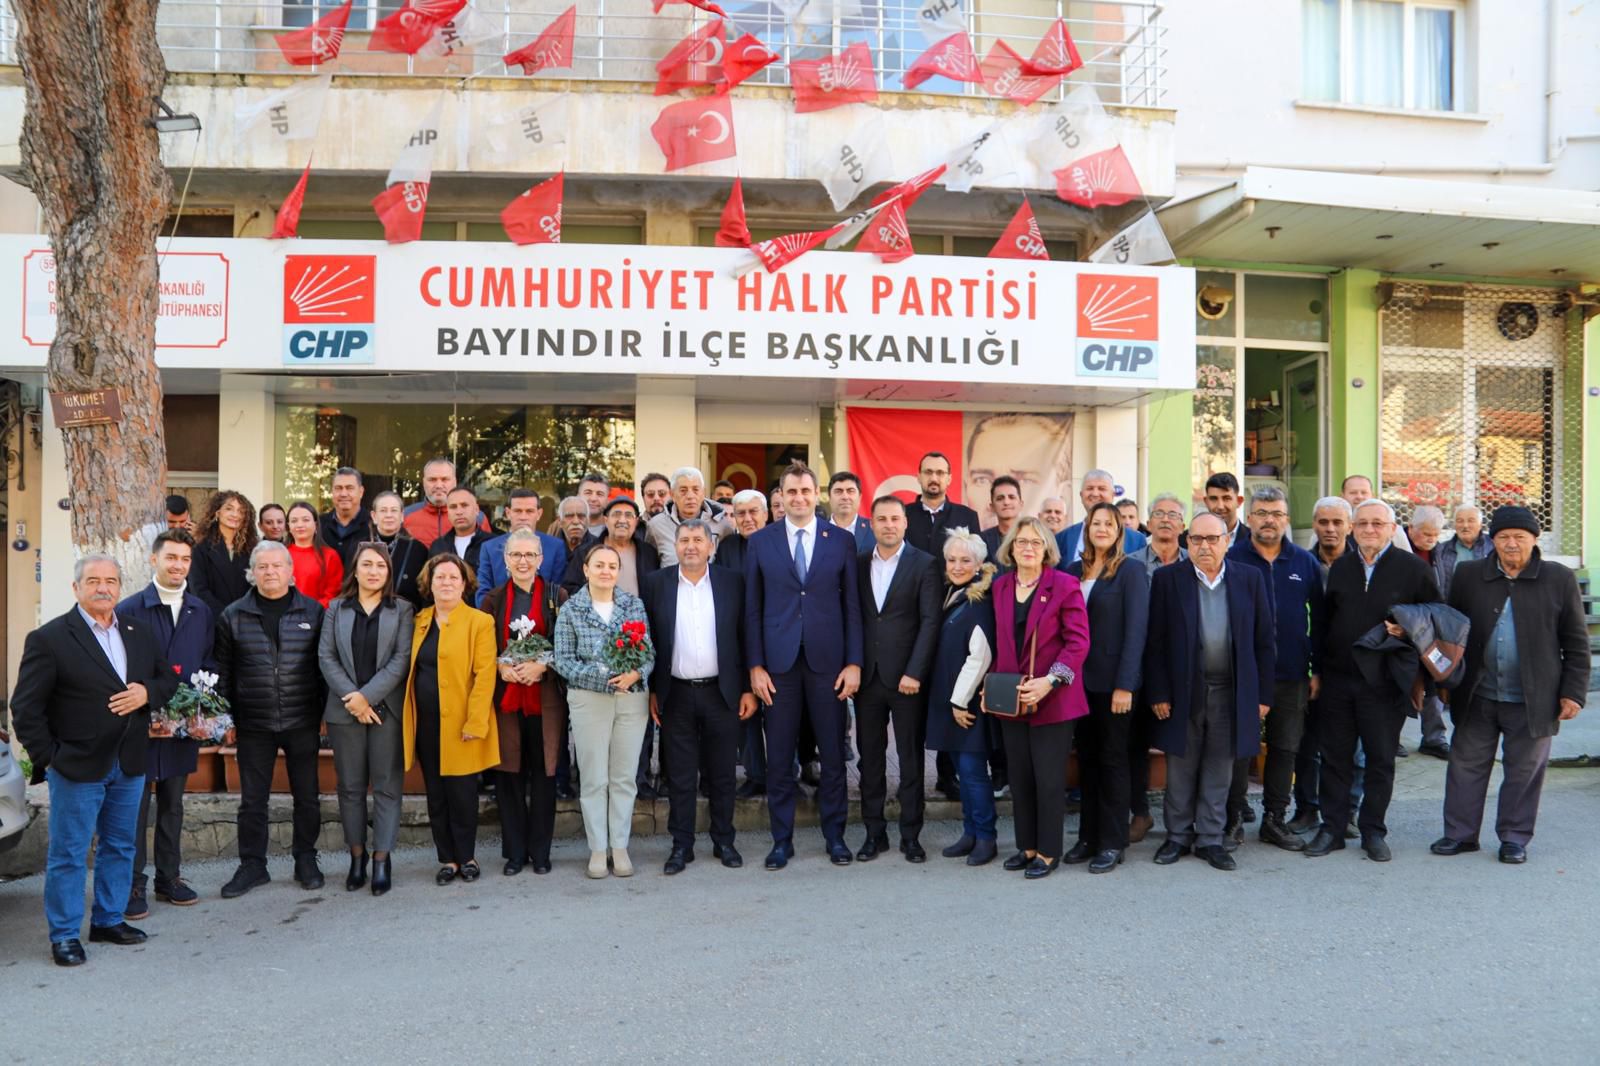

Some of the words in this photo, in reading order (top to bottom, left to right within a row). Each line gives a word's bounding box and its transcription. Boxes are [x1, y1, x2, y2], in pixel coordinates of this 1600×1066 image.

[400, 11, 432, 36] CH
[311, 35, 334, 61] CH
[270, 104, 289, 136] HP
[408, 129, 438, 148] HP
[958, 156, 984, 177] HP
[158, 280, 205, 296] AKANLIĞI
[419, 258, 715, 311] CUMHURİYET
[737, 271, 848, 314] HALK
[871, 269, 1037, 320] PARTİSİ
[158, 301, 223, 317] ÜTÜPHANESİ
[289, 330, 369, 360] CHP
[436, 327, 642, 358] BAYINDIR
[662, 321, 746, 367] İLÇE
[767, 329, 1019, 370] BAŞKANLIĞI
[1082, 343, 1154, 373] CHP
